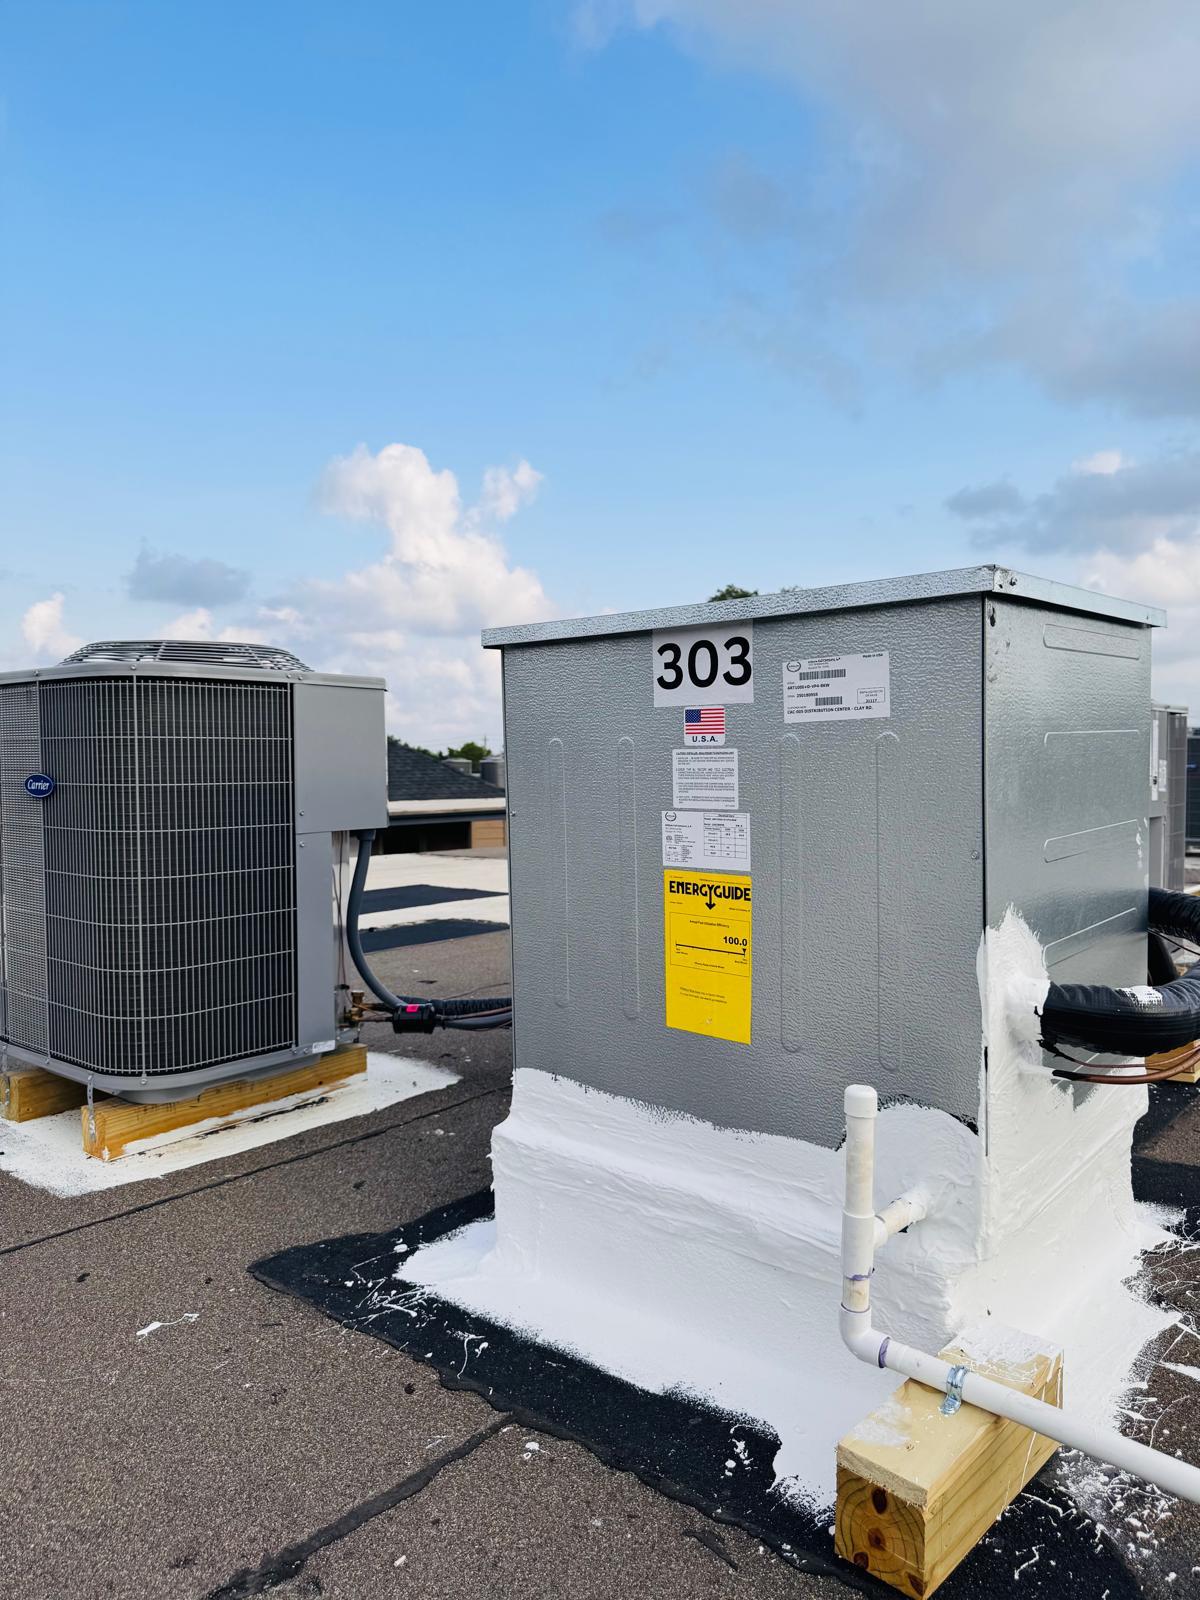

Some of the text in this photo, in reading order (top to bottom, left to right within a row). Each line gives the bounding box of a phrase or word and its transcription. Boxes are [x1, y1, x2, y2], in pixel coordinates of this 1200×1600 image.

[656, 636, 752, 690] 303
[692, 735, 718, 743] U.S.A.
[27, 779, 50, 790] Carrier
[669, 880, 752, 903] ENERGYGUIDE
[723, 936, 748, 947] 100.0
